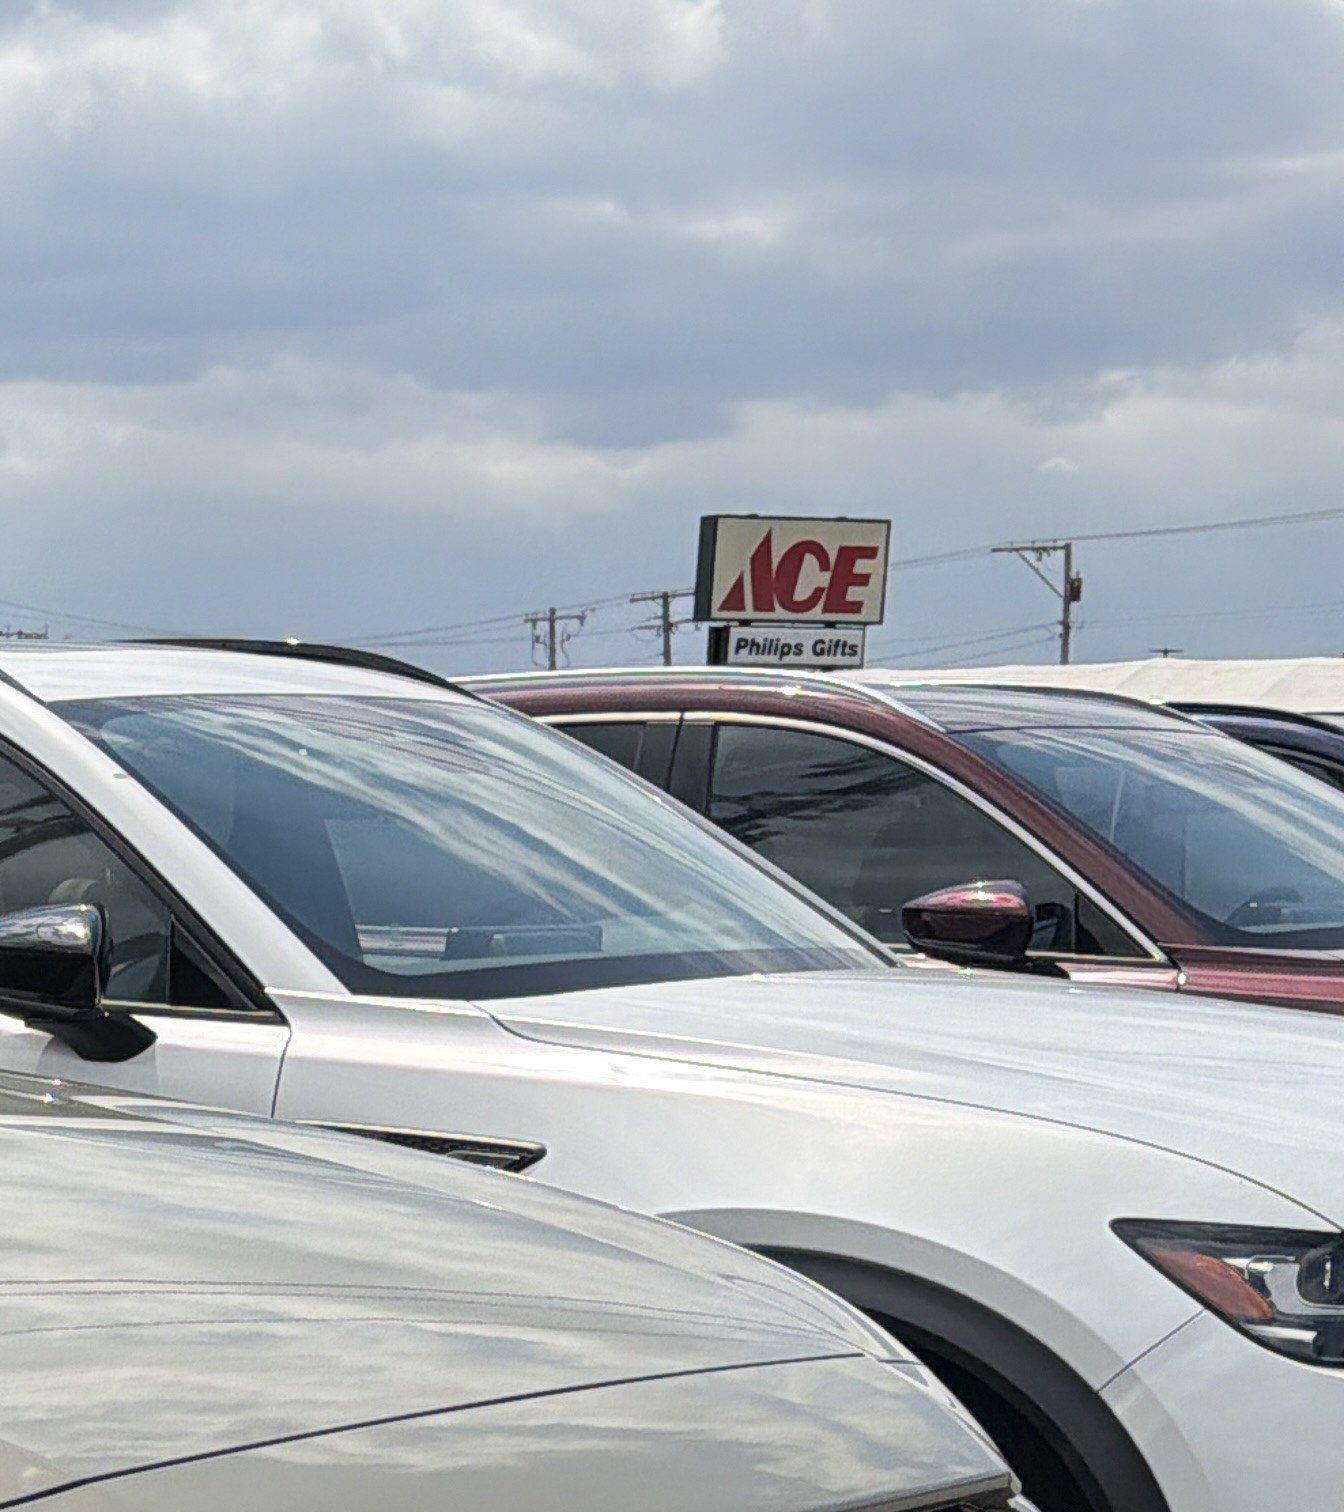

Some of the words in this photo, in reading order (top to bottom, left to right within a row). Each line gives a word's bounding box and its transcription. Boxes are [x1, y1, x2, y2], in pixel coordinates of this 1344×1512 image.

[717, 527, 879, 614] ACE
[734, 637, 804, 661] Philips
[811, 638, 859, 658] Gifts
